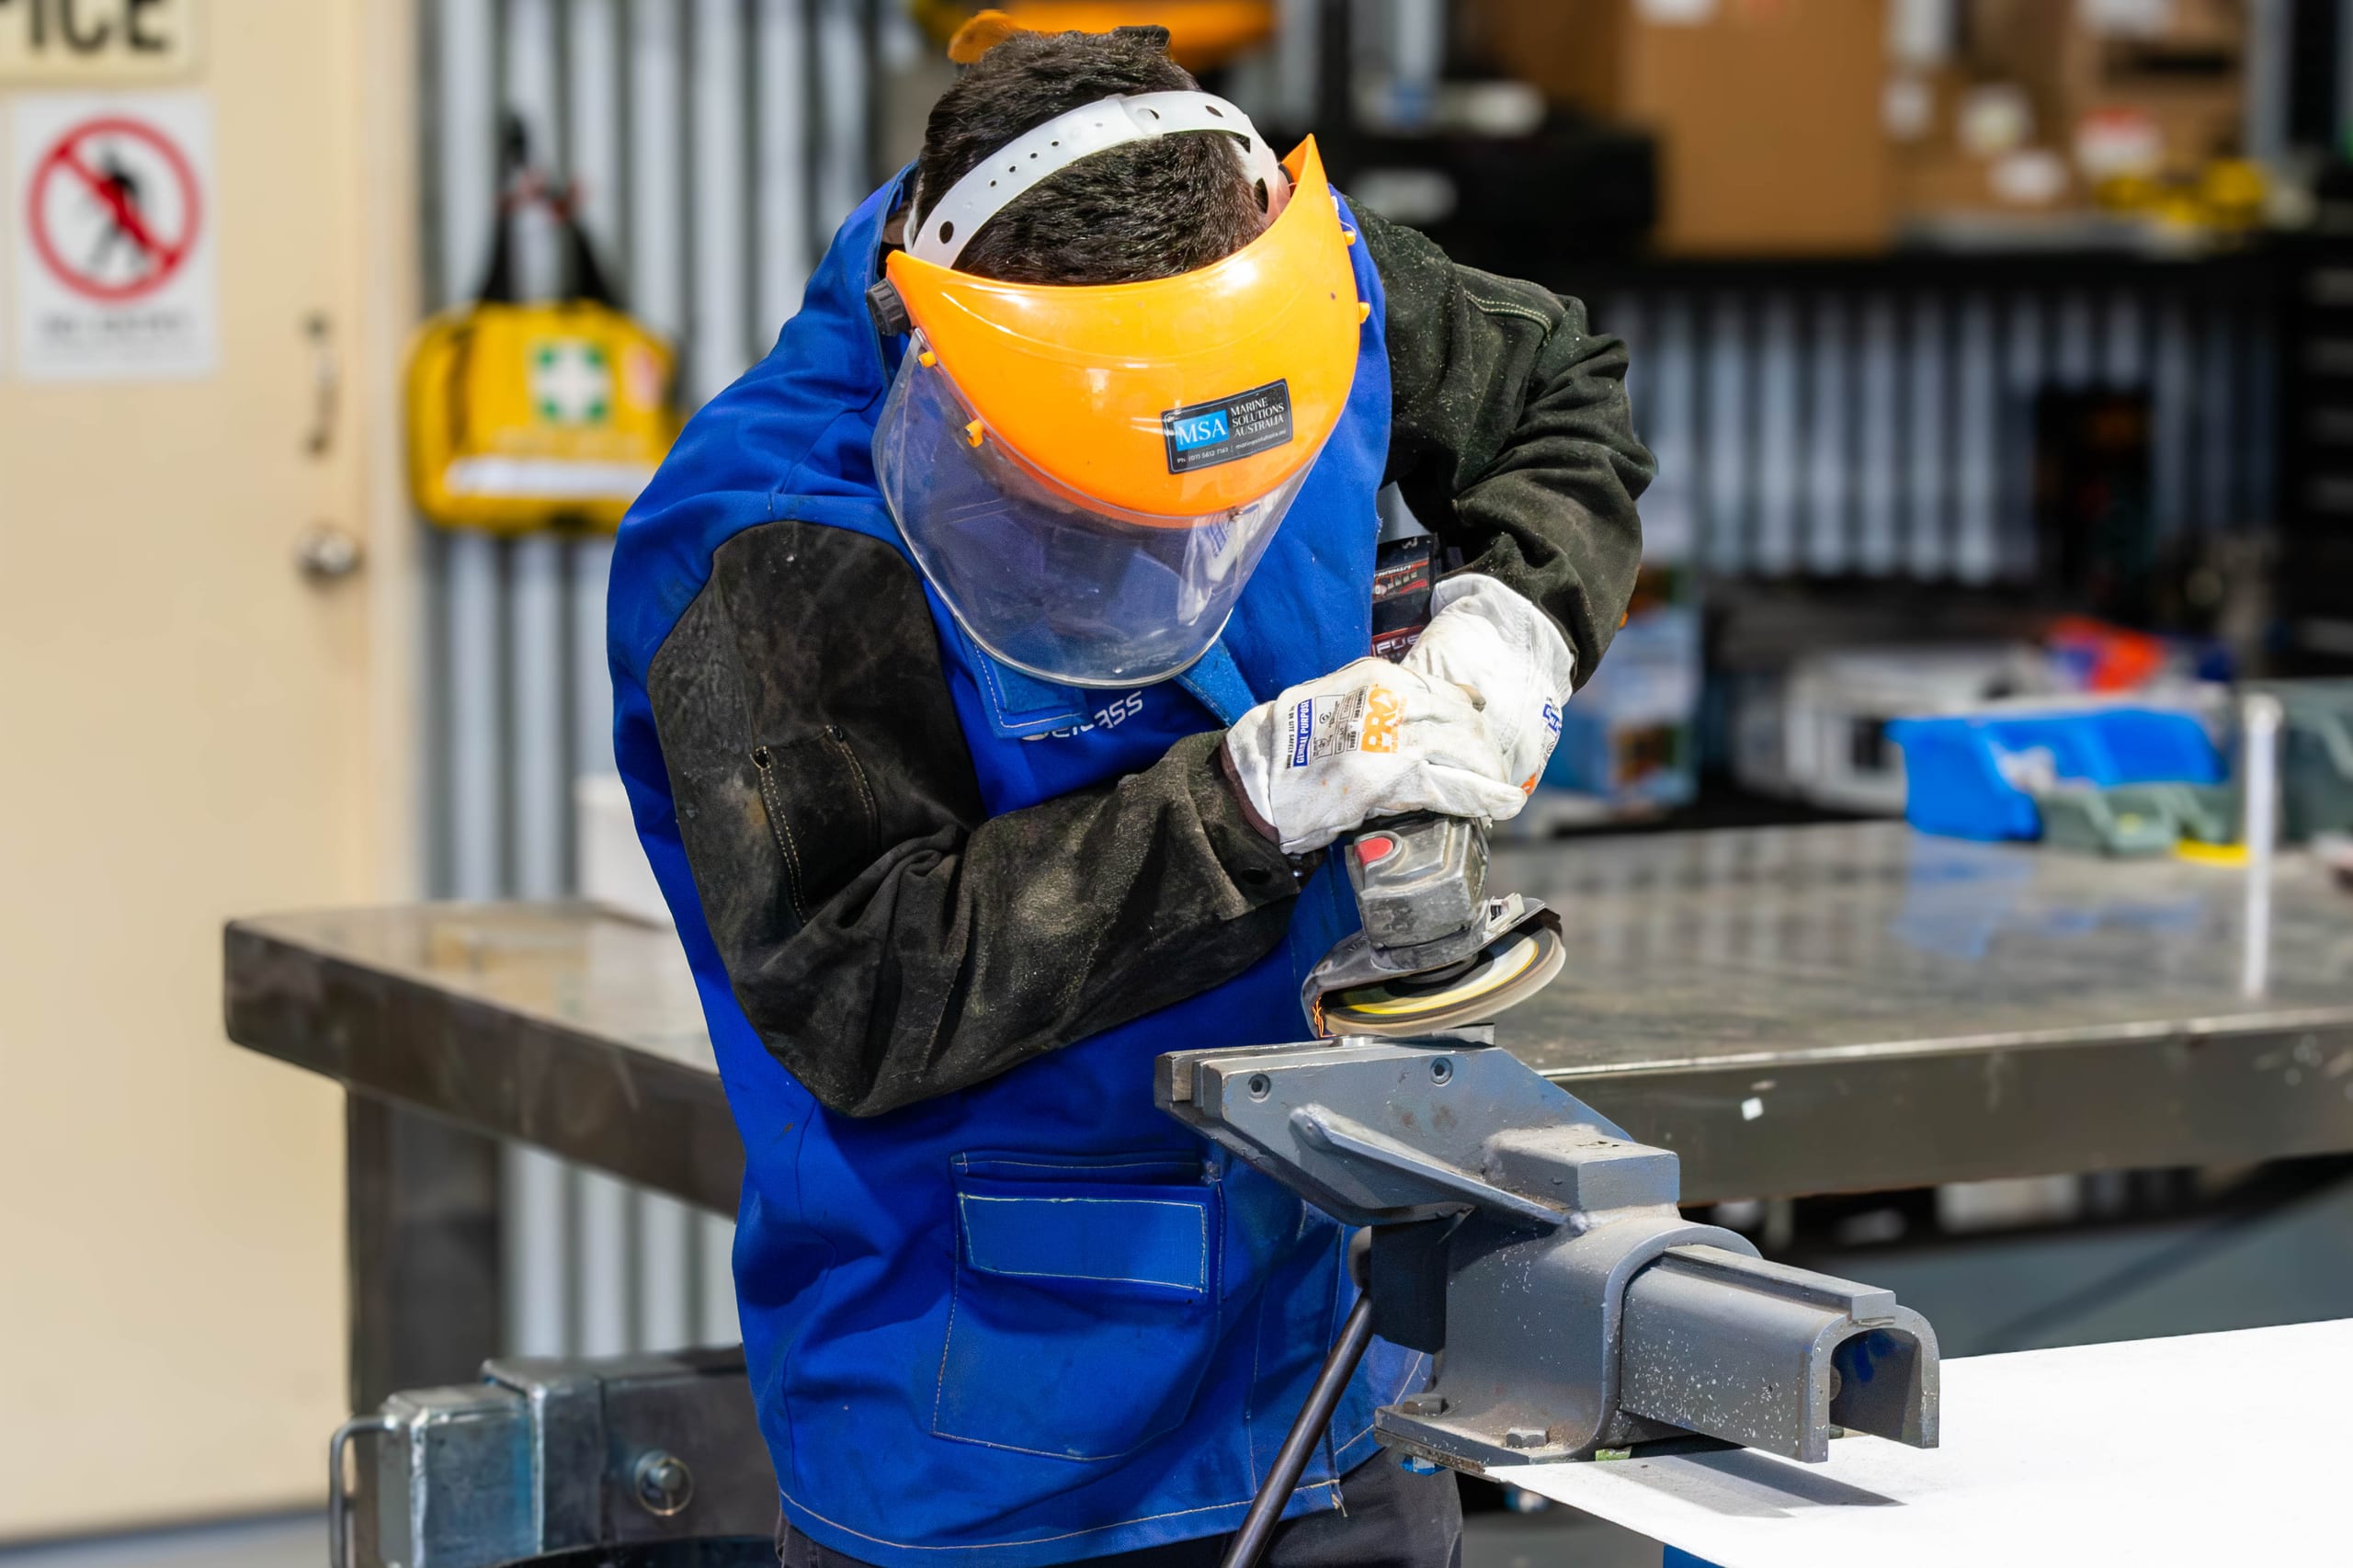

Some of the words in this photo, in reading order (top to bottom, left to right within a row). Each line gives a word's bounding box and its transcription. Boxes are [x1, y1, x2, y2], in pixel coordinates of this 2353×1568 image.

[0, 0, 167, 53] ICE
[1231, 397, 1268, 417] MARINE
[1233, 403, 1285, 427] SOLUTIONS
[1177, 418, 1228, 446] MSA
[1233, 415, 1284, 437] AUSTRALIA
[1376, 634, 1420, 654] FUE
[1361, 687, 1398, 754] PRO
[1296, 735, 1309, 764] GENERAL
